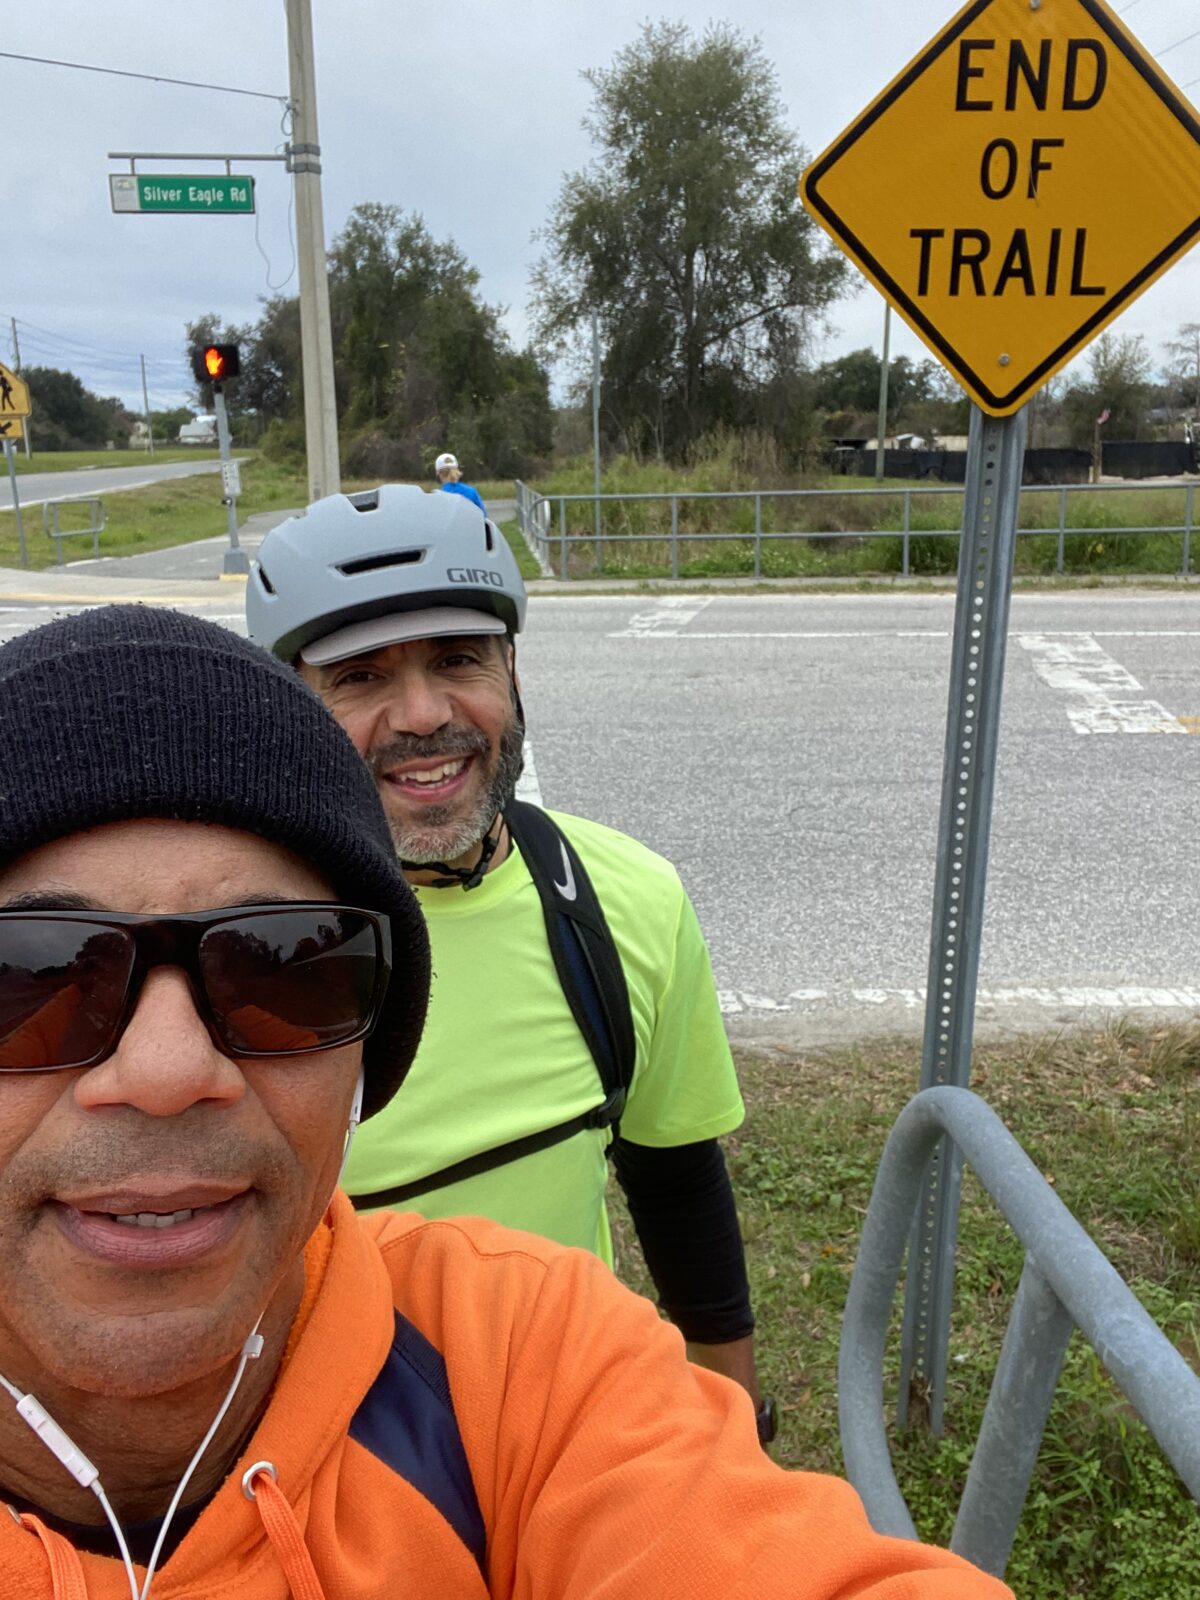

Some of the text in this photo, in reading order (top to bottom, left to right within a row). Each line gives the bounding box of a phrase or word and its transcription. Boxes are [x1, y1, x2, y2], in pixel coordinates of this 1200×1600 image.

[955, 39, 1108, 112] END
[143, 186, 247, 205] Silver Eagle Rd
[980, 138, 1065, 200] OF
[909, 228, 1106, 297] TRAIL
[446, 568, 504, 587] GIRO
